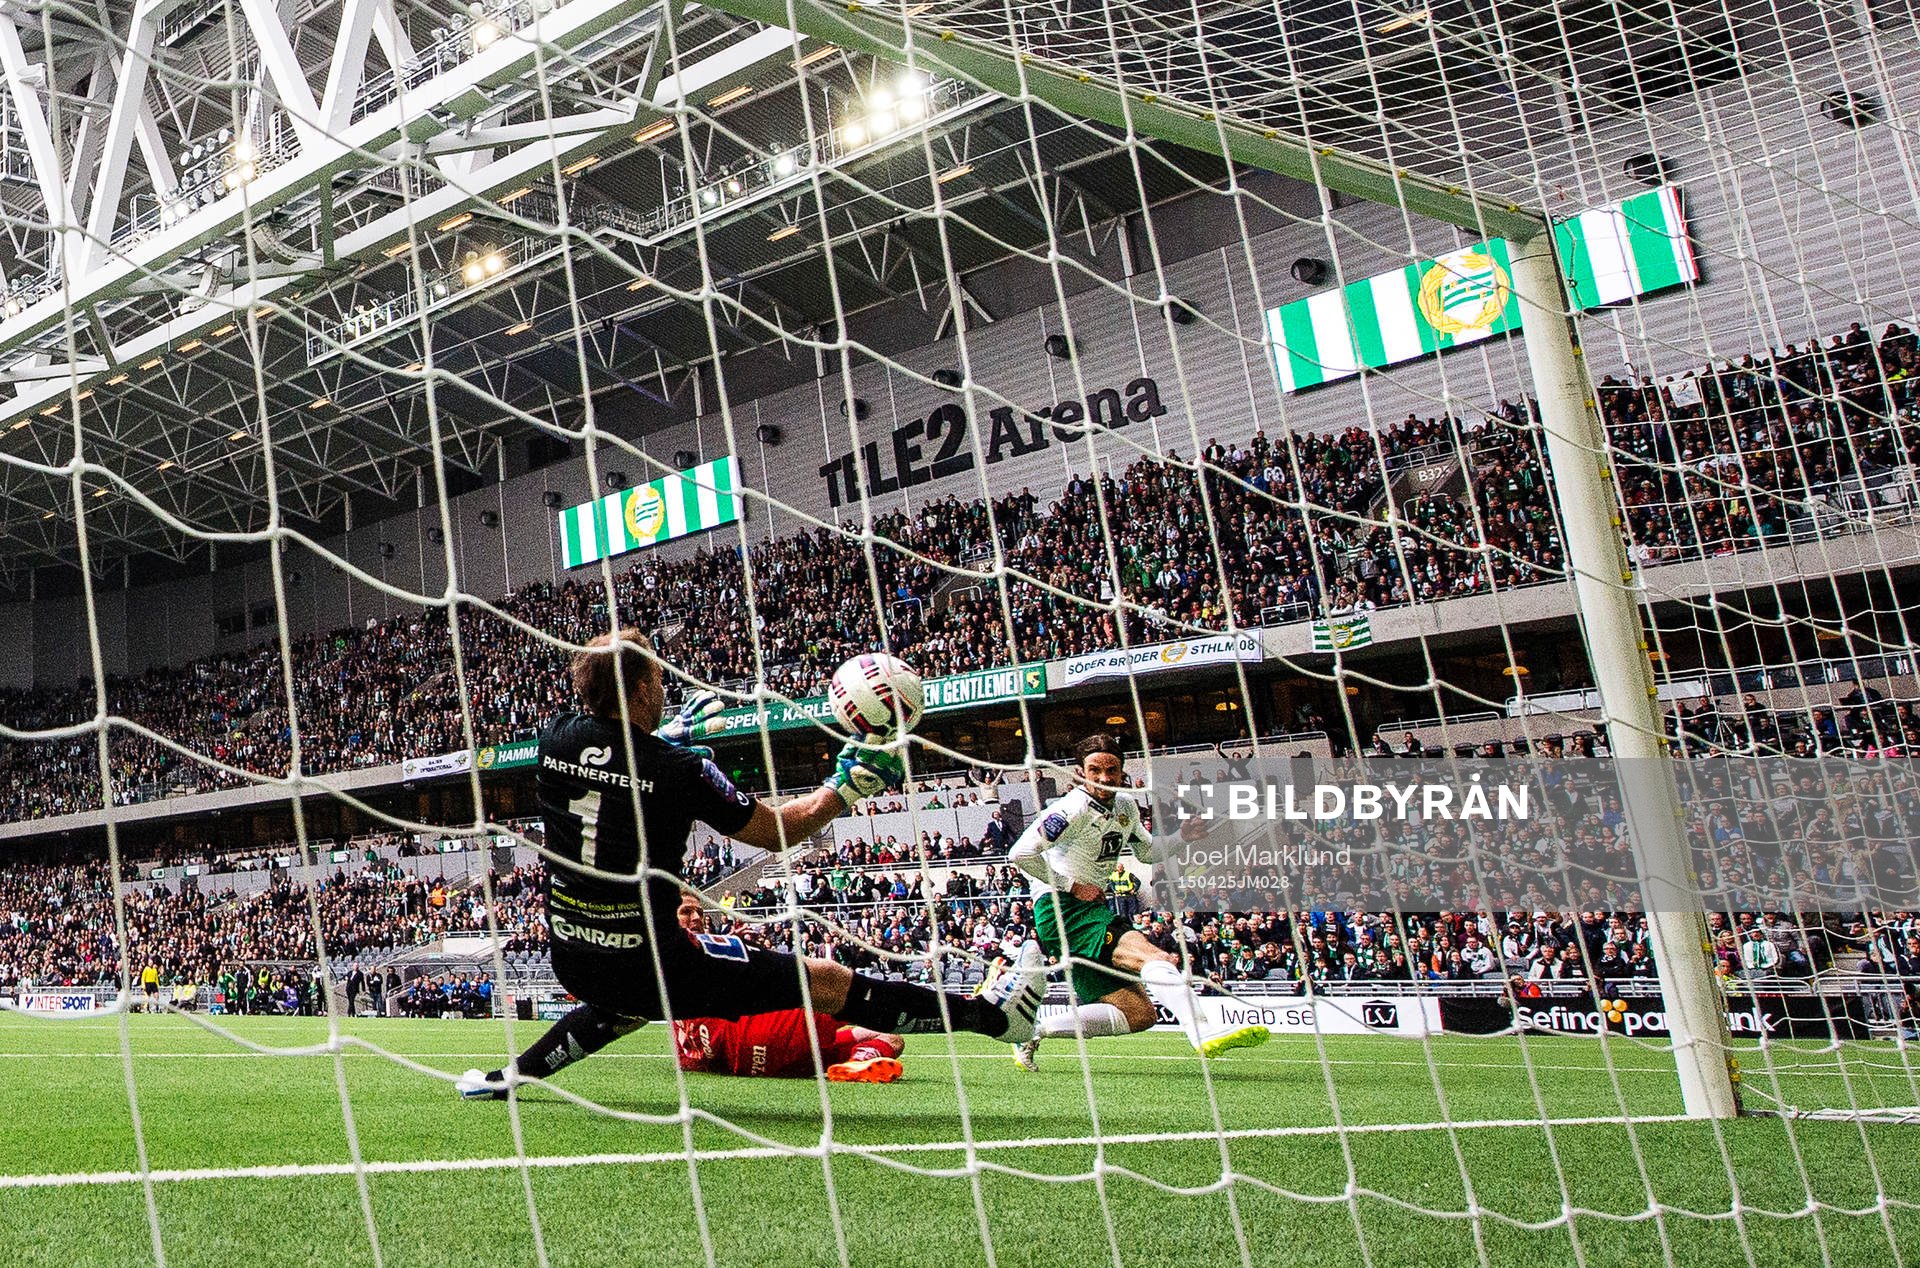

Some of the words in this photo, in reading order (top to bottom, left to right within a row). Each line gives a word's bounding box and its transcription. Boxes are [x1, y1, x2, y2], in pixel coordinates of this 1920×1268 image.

[819, 403, 974, 507] TELE2
[985, 377, 1168, 464] Arena
[1068, 657, 1105, 675] SÖDER
[1239, 639, 1256, 652] 08
[543, 755, 654, 793] PARTNERTECH
[568, 789, 602, 868] 1
[551, 914, 643, 949] CONRAD
[34, 996, 92, 1010] INTERSPORT
[1221, 1004, 1315, 1026] lwab.se
